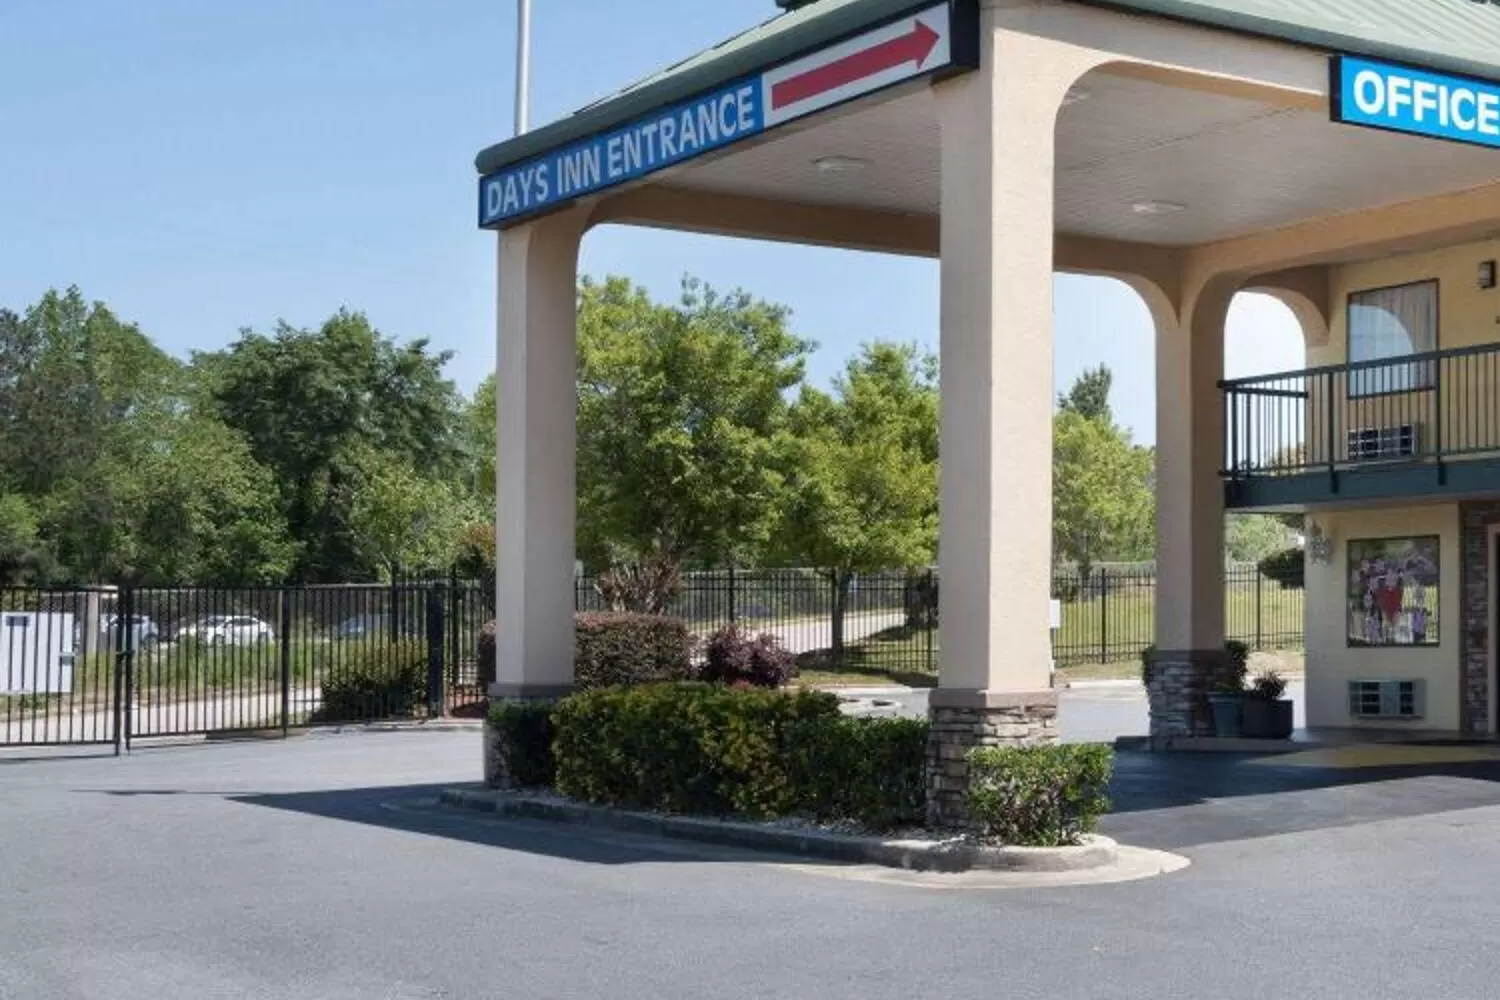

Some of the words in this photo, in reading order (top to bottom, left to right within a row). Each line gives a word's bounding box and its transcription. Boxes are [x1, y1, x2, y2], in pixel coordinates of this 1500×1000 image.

[486, 163, 550, 218] DAYS
[556, 143, 601, 196] INN
[607, 84, 754, 179] ENTRANCE
[1353, 69, 1500, 135] OFFICE
